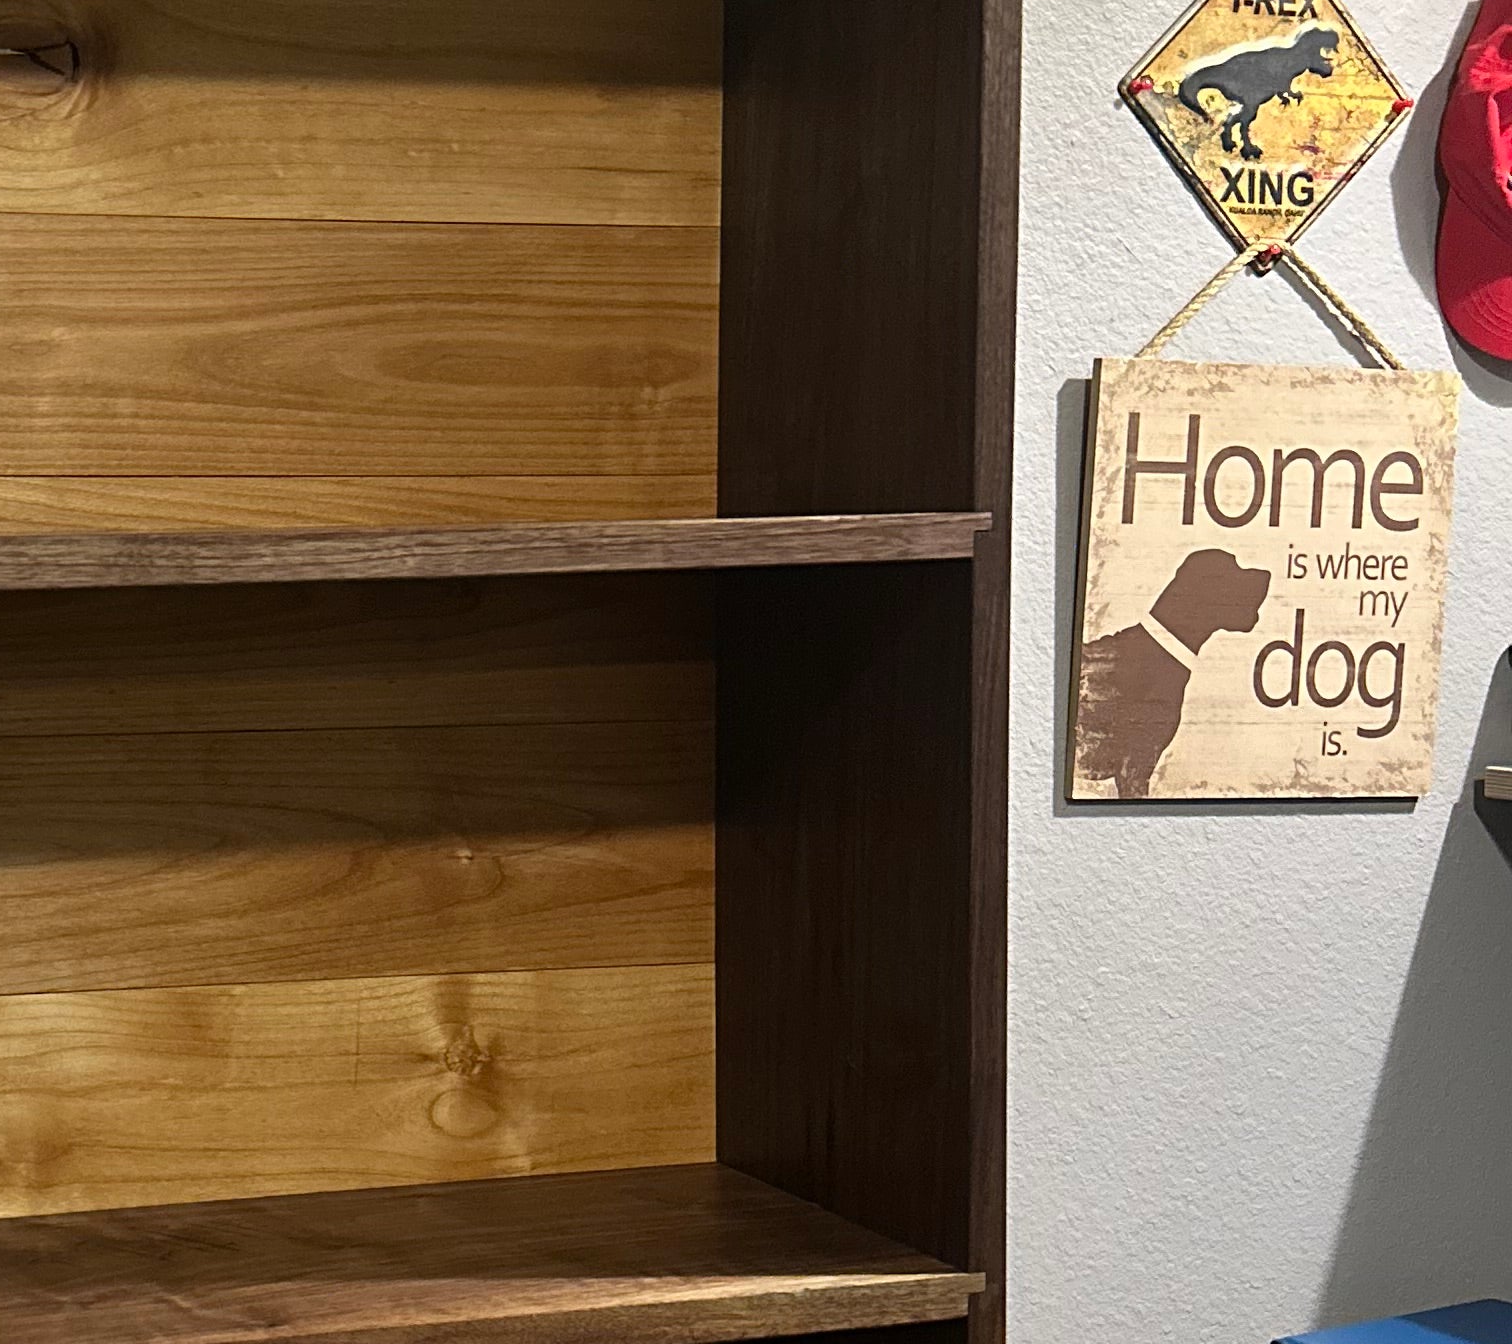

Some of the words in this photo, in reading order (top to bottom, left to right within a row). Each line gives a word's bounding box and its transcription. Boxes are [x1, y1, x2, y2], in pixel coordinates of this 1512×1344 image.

[1219, 166, 1314, 207] XING
[1121, 411, 1424, 532] Home
[1286, 544, 1308, 580] is
[1316, 542, 1409, 581] where
[1358, 590, 1409, 628] my
[1252, 608, 1406, 739] dog
[1320, 721, 1348, 757] is.
